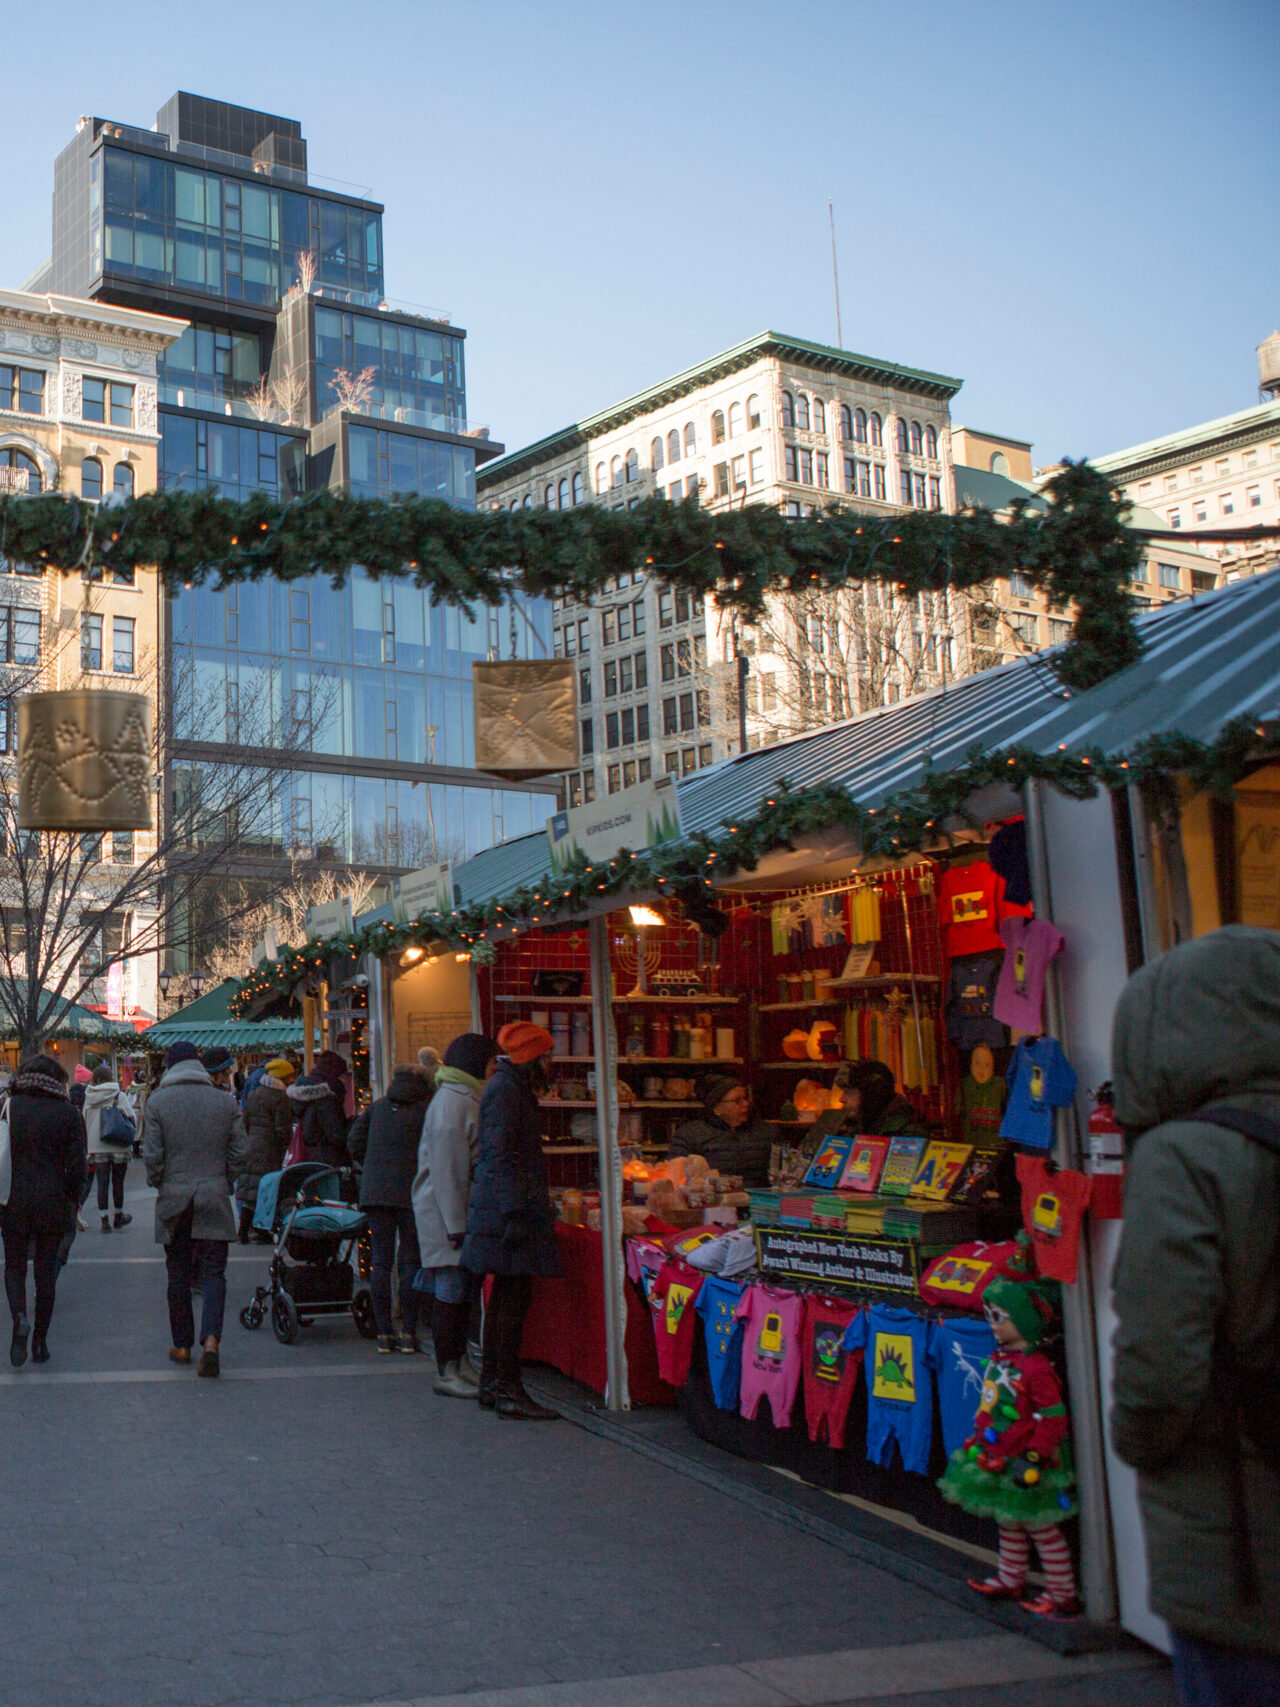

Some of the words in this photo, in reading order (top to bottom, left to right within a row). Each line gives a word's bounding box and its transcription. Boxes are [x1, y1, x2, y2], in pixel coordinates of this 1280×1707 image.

[587, 813, 631, 835] KIPKIDS.COM
[767, 1236, 818, 1255] Autographed
[818, 1242, 837, 1256] New
[837, 1244, 860, 1260] York
[860, 1246, 889, 1263] Books
[890, 1250, 904, 1267] By
[762, 1254, 789, 1269] Award
[790, 1257, 825, 1277] Winning
[825, 1262, 855, 1279] Author
[855, 1266, 864, 1280] &
[865, 1267, 915, 1287] Illustrator
